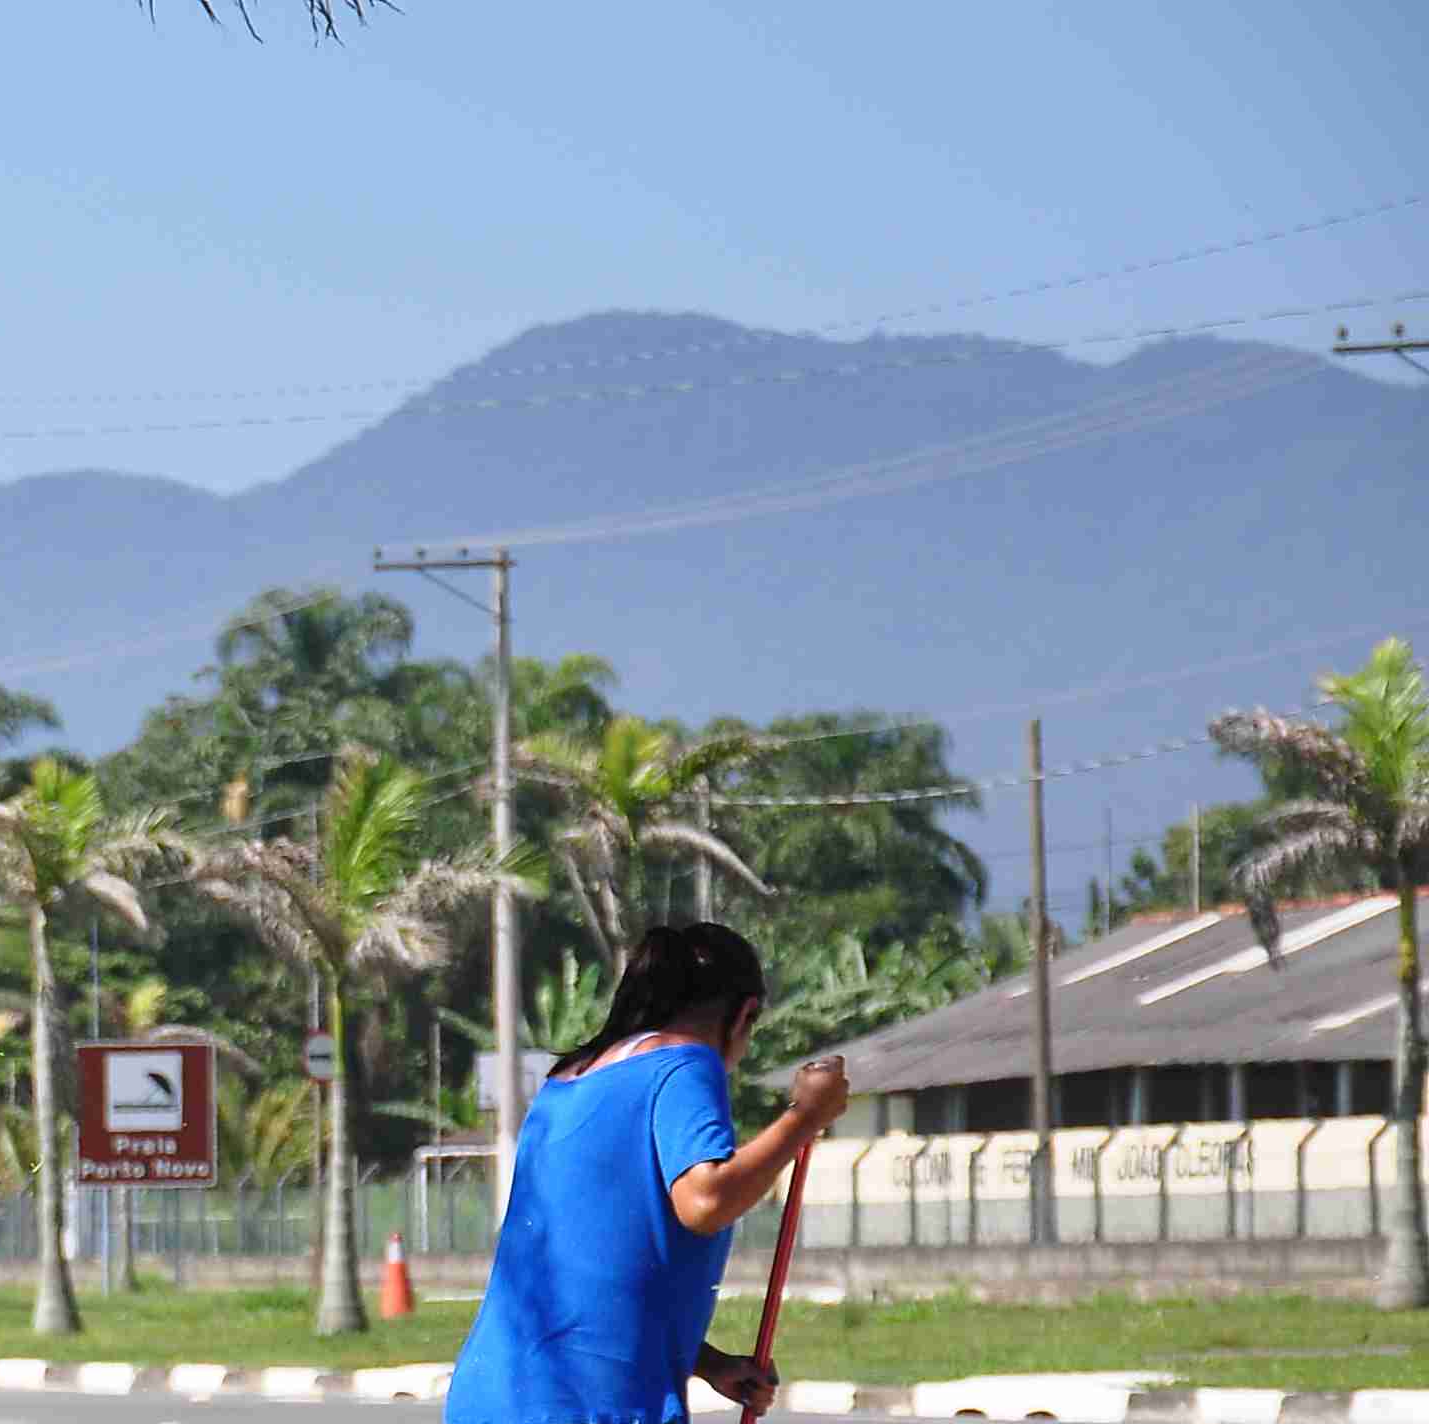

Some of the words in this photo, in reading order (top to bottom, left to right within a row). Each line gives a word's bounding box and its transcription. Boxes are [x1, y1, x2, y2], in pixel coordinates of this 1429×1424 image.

[116, 1137, 177, 1155] Praia
[83, 1160, 145, 1178] Porto
[156, 1160, 209, 1177] Novo
